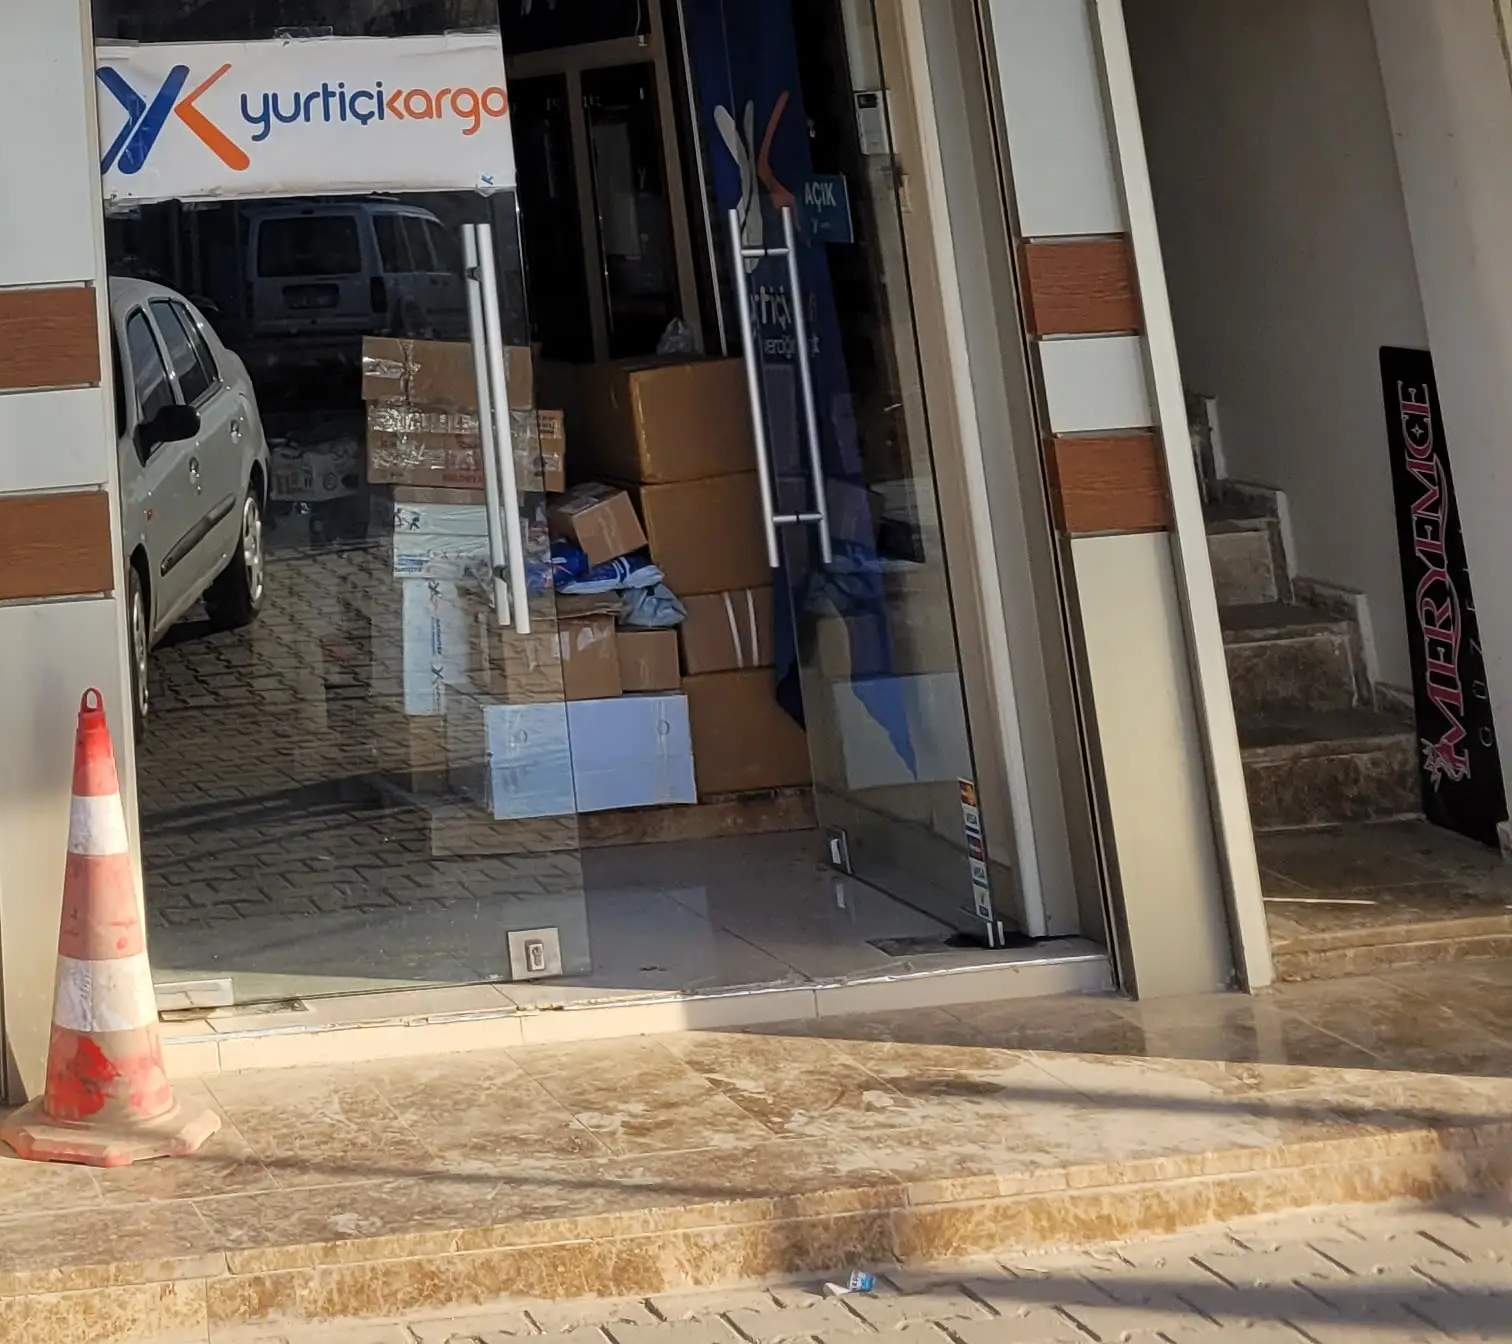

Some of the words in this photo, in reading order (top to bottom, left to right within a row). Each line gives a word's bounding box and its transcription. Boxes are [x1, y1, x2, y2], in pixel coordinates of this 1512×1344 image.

[240, 80, 509, 142] yurtiçikargo
[804, 181, 838, 213] AÇIK
[1397, 380, 1472, 780] MERYEMCE
